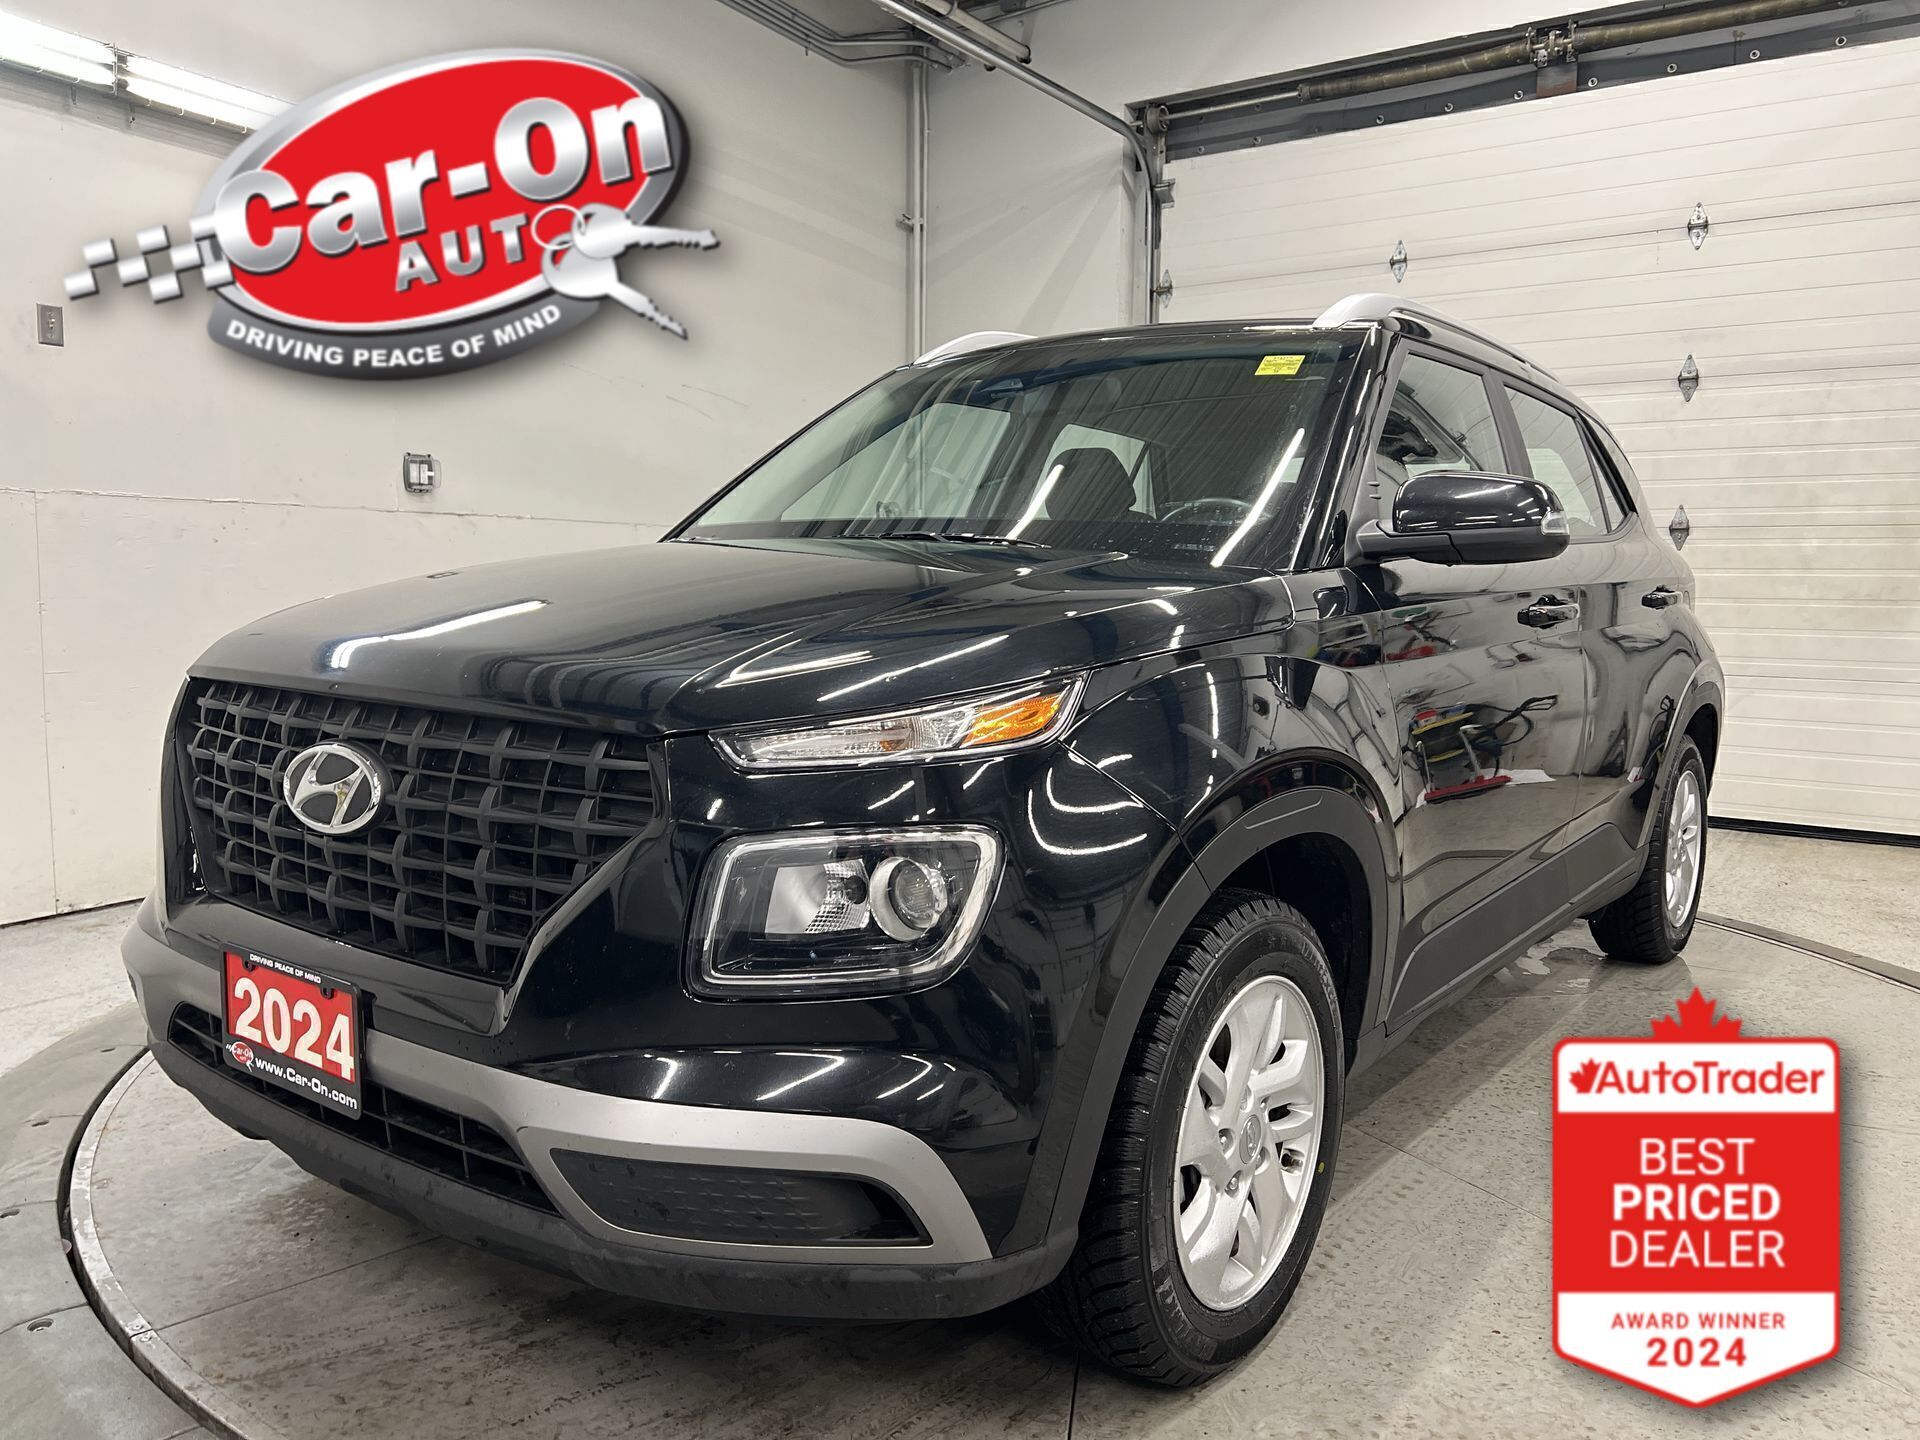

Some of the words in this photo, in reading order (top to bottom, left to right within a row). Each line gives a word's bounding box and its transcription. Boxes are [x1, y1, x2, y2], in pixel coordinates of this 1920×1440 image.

[250, 954, 273, 967] DRIVING
[275, 961, 294, 974] PEACE
[295, 969, 303, 977] OF
[305, 972, 321, 983] MIND
[234, 977, 354, 1083] 2024
[255, 1057, 358, 1110] www.Car-On.com
